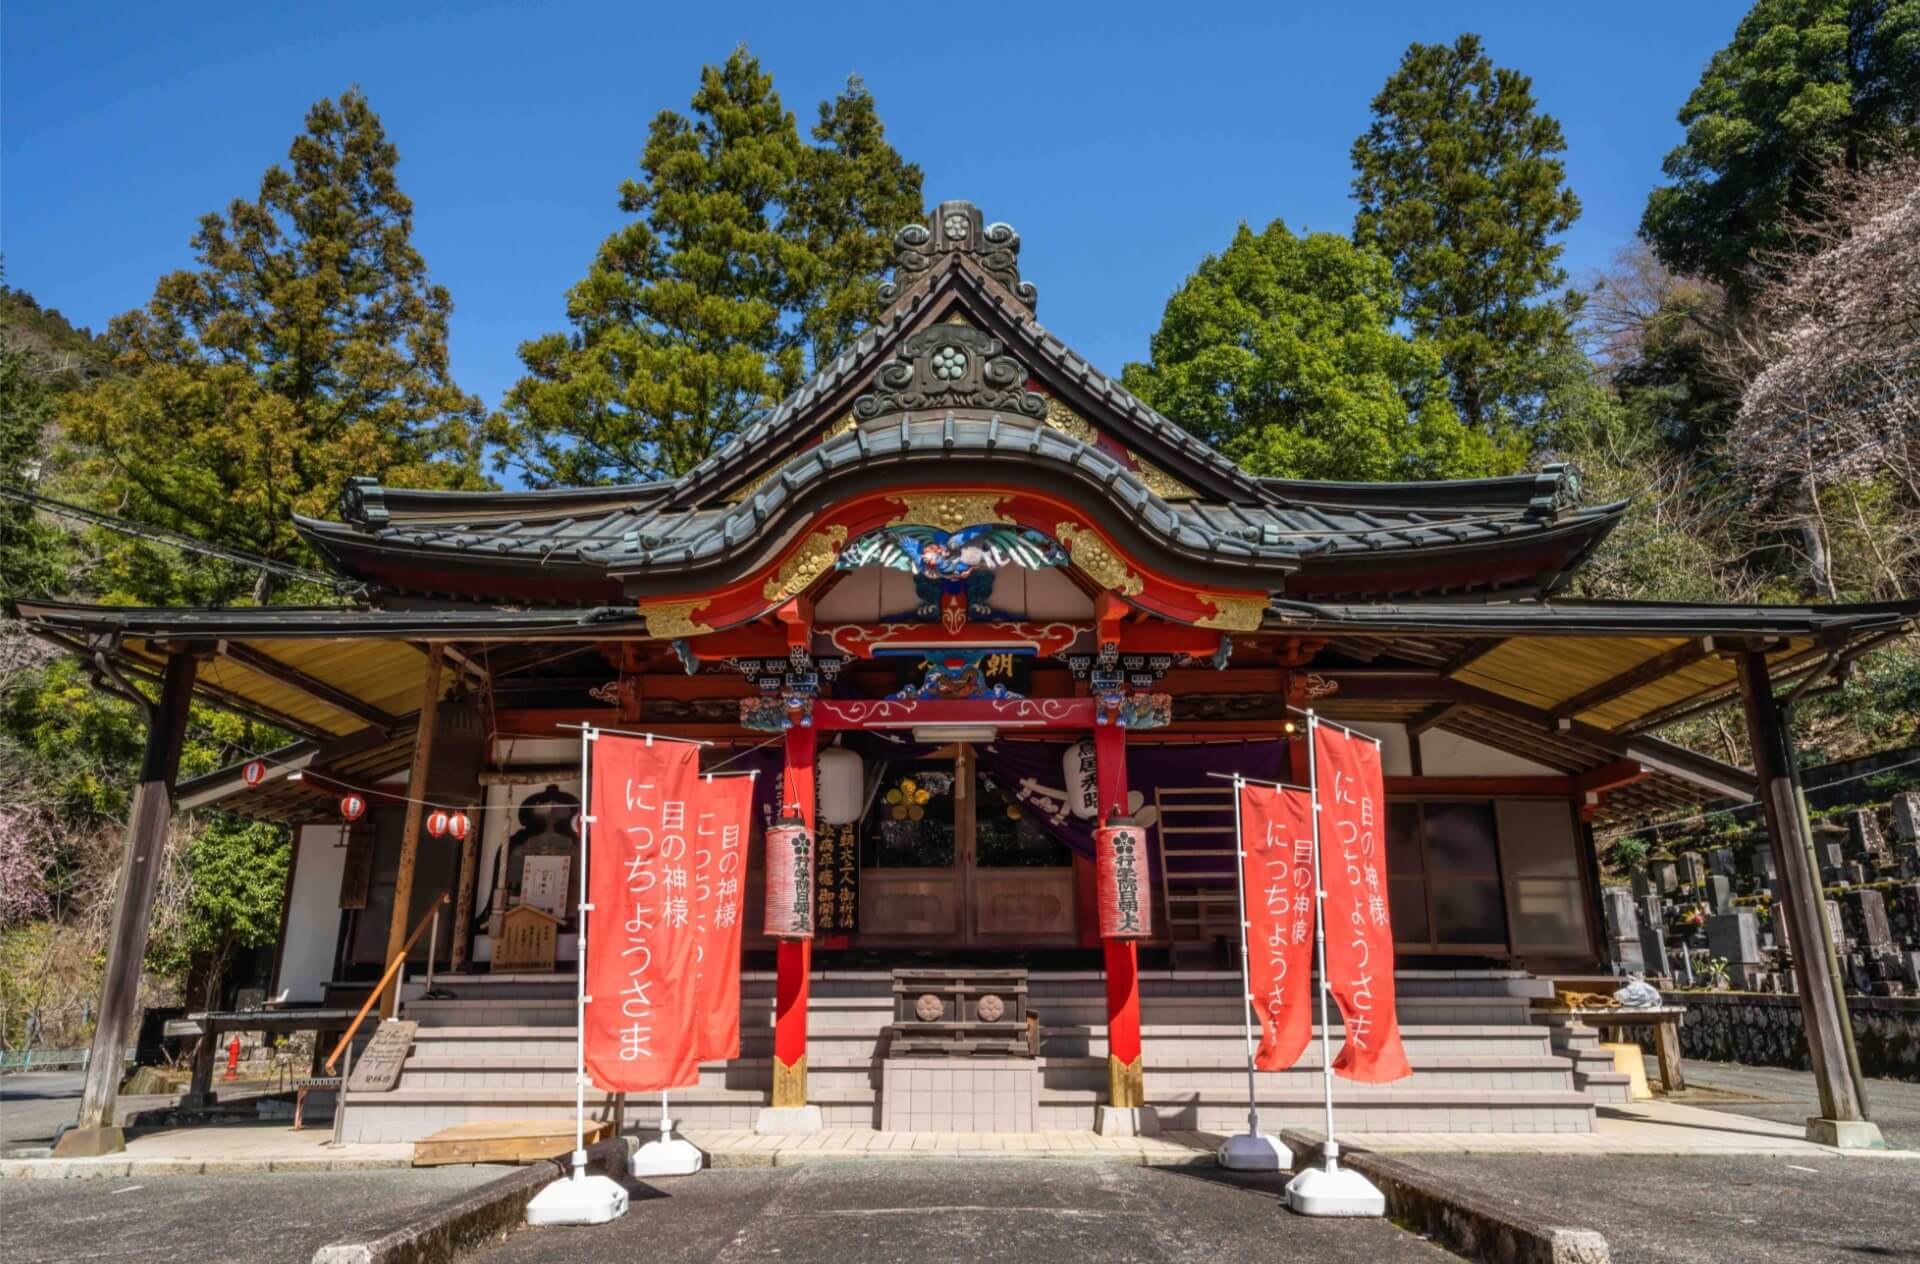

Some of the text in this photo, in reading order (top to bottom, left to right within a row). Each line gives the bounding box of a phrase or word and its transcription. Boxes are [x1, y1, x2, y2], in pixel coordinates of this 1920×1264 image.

[619, 779, 656, 1061] にっちょうさま
[661, 801, 688, 929] 目の神様
[713, 824, 739, 929] 目の神様
[1291, 839, 1312, 945] 目の神様
[1334, 771, 1373, 1049] にっちょうさま
[1360, 797, 1388, 927] 目の神様
